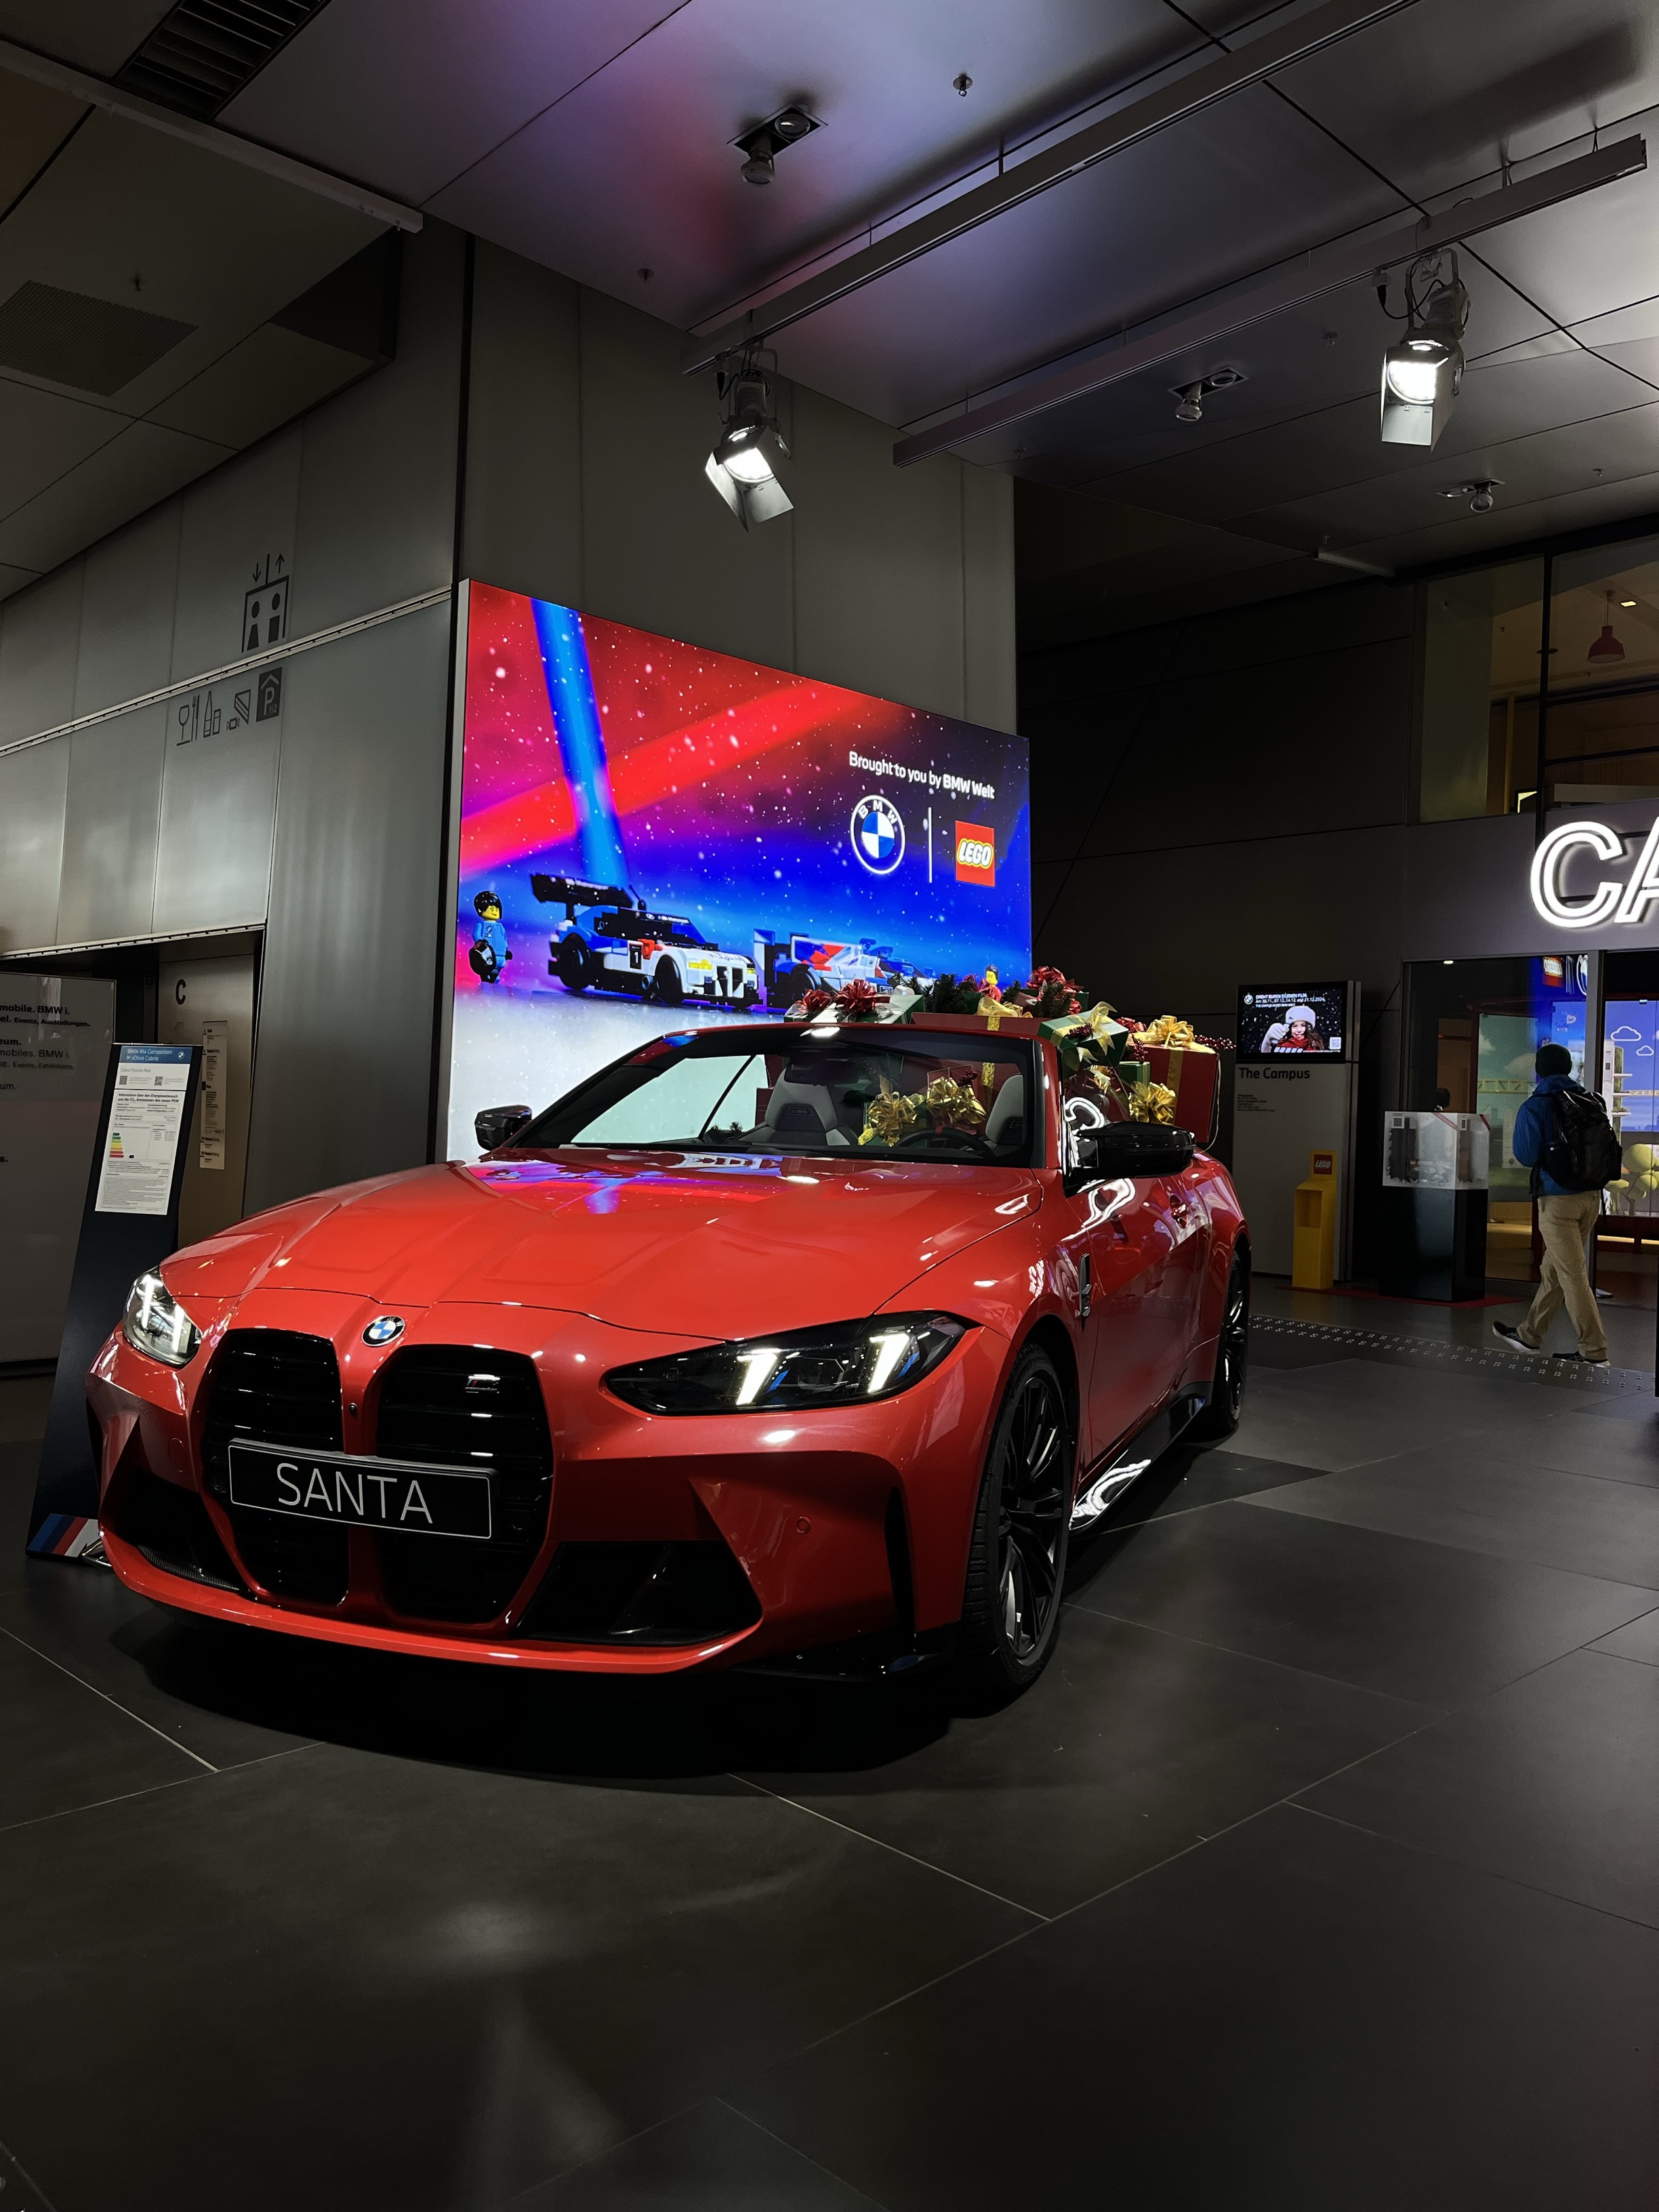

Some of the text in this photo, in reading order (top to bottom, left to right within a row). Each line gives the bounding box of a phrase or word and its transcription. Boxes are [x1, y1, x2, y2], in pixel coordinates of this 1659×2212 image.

[849, 751, 996, 800] Brought to you by BMW Welt
[857, 800, 898, 824] BMW
[958, 840, 992, 867] LEGO
[634, 951, 639, 964] 1
[176, 979, 187, 1005] C
[0, 1004, 70, 1015] mobile. BMW i.
[14, 1017, 39, 1025] Events,
[41, 1019, 91, 1027] Ausstellungen.
[39, 1049, 64, 1059] BMW
[1238, 1067, 1311, 1082] The Campus
[1315, 1160, 1331, 1168] LEGO
[276, 1462, 434, 1524] SANTA
